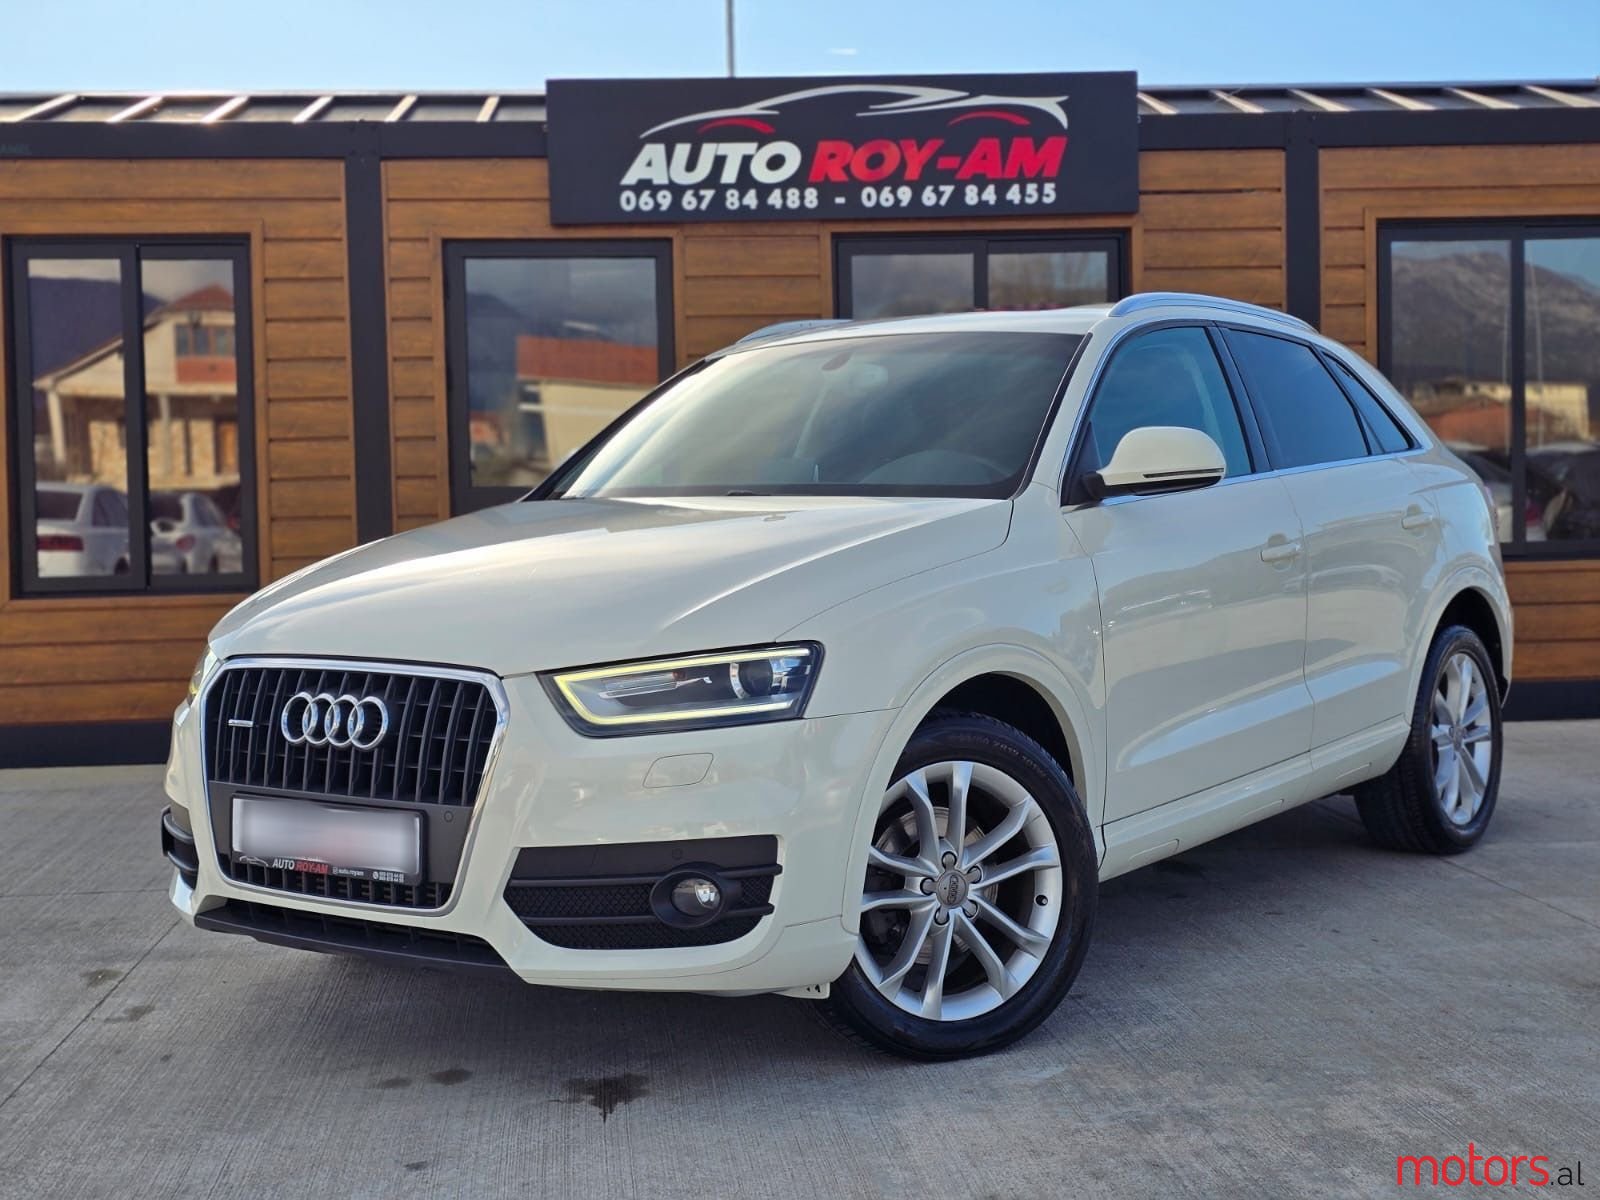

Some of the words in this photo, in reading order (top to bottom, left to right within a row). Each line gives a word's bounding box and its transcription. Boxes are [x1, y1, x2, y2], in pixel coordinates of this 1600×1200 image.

[620, 141, 802, 186] AUTO
[808, 137, 1068, 182] ROY-AM
[620, 190, 671, 212] 069
[681, 189, 712, 211] 67
[725, 188, 758, 210] 84
[767, 187, 818, 210] 488
[861, 185, 912, 208] 069
[922, 184, 954, 207] 67
[964, 184, 996, 206] 84
[1005, 183, 1057, 205] 455
[272, 858, 295, 871] AUTO
[295, 860, 329, 874] ROY-AM
